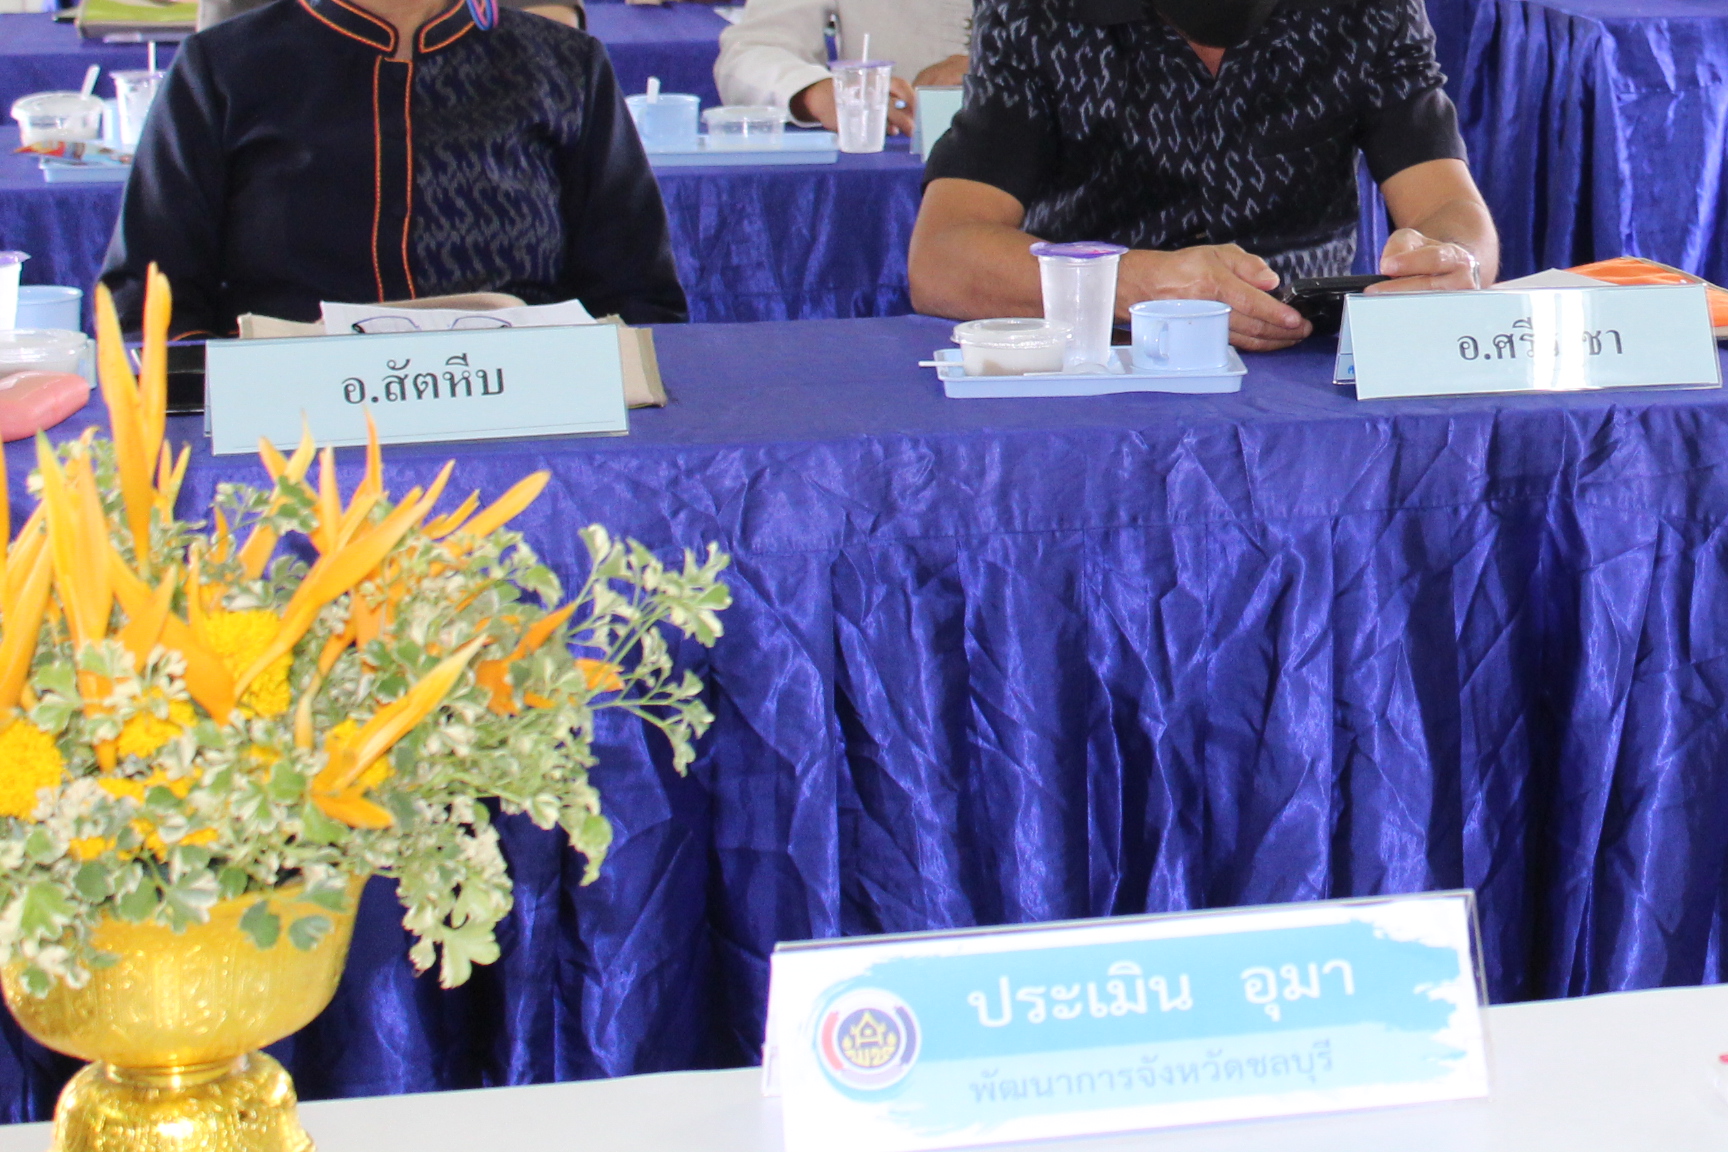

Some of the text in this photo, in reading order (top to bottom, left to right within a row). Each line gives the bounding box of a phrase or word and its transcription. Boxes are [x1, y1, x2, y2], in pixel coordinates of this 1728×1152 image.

[1456, 316, 1625, 362] อ.ศรีชา
[341, 352, 506, 406] อ.สัตหีบ
[966, 958, 1358, 1028] ประเมิน อุมา
[968, 1039, 1335, 1104] พัฒนาการจังหวัดชลบุรี
